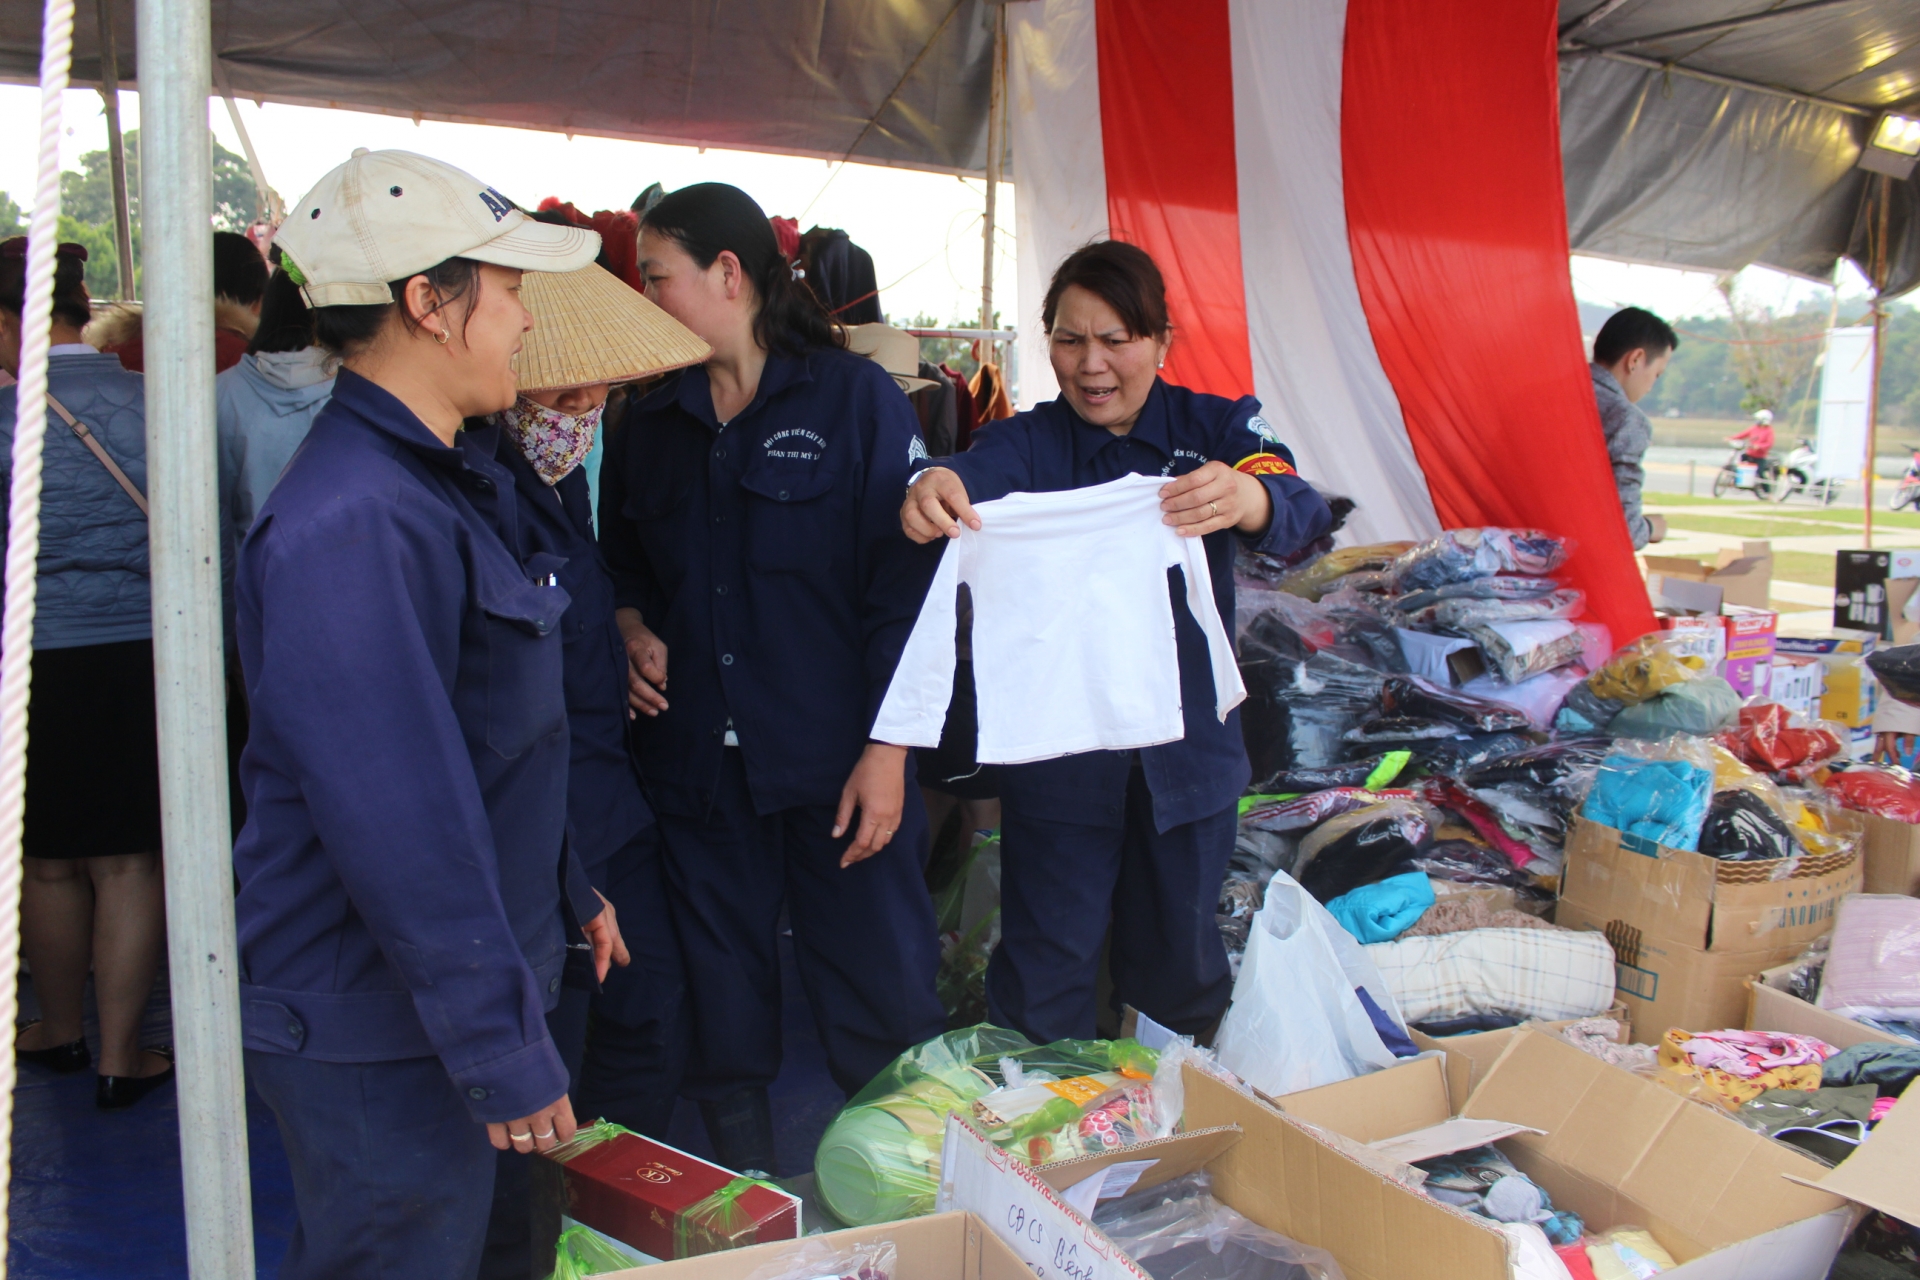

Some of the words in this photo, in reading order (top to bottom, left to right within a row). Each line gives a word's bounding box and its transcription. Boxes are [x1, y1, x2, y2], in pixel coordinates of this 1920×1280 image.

[773, 429, 790, 441] CÔNG
[767, 449, 785, 458] PHAN
[1186, 450, 1199, 459] CÂY
